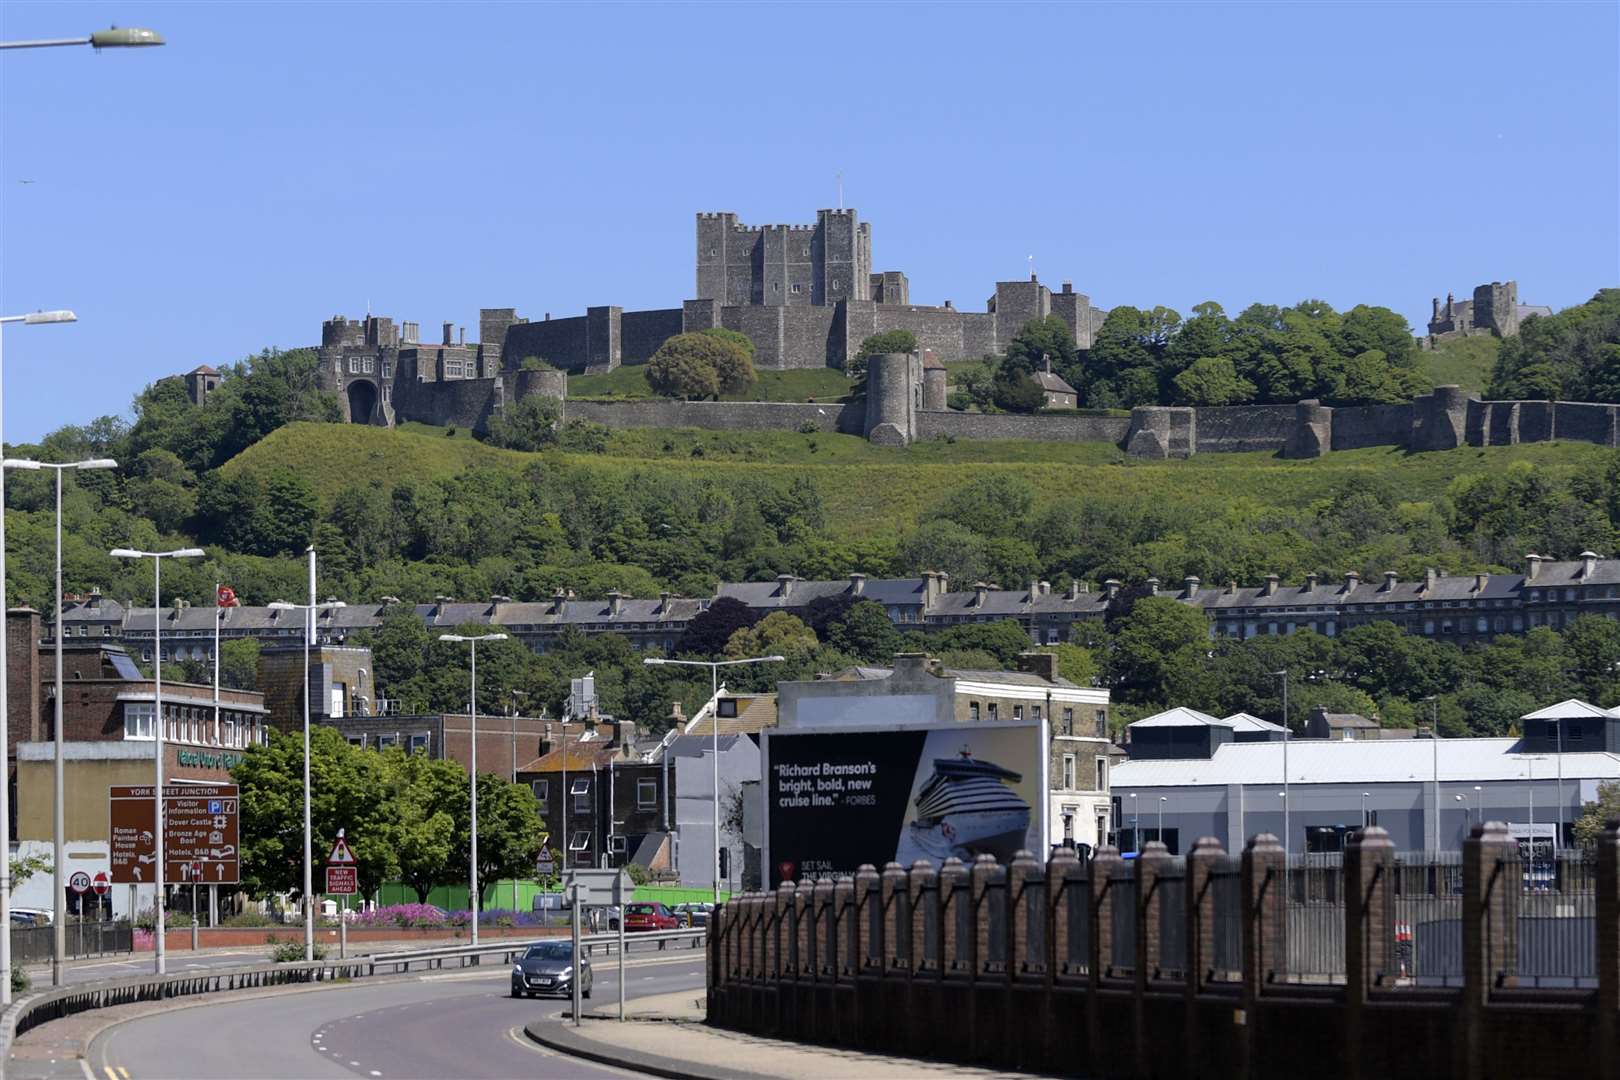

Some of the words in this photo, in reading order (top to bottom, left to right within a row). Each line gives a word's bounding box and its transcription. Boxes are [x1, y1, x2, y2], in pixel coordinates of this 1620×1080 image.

[822, 762, 876, 775] Branson’s
[780, 779, 815, 794] bright,
[817, 778, 845, 792] bold,
[848, 780, 872, 790] new
[780, 794, 810, 807] cruise
[846, 795, 876, 805] FORBES
[801, 860, 815, 870] SET
[816, 860, 832, 870] SAIL
[802, 872, 817, 880] THE
[73, 878, 88, 887] 40
